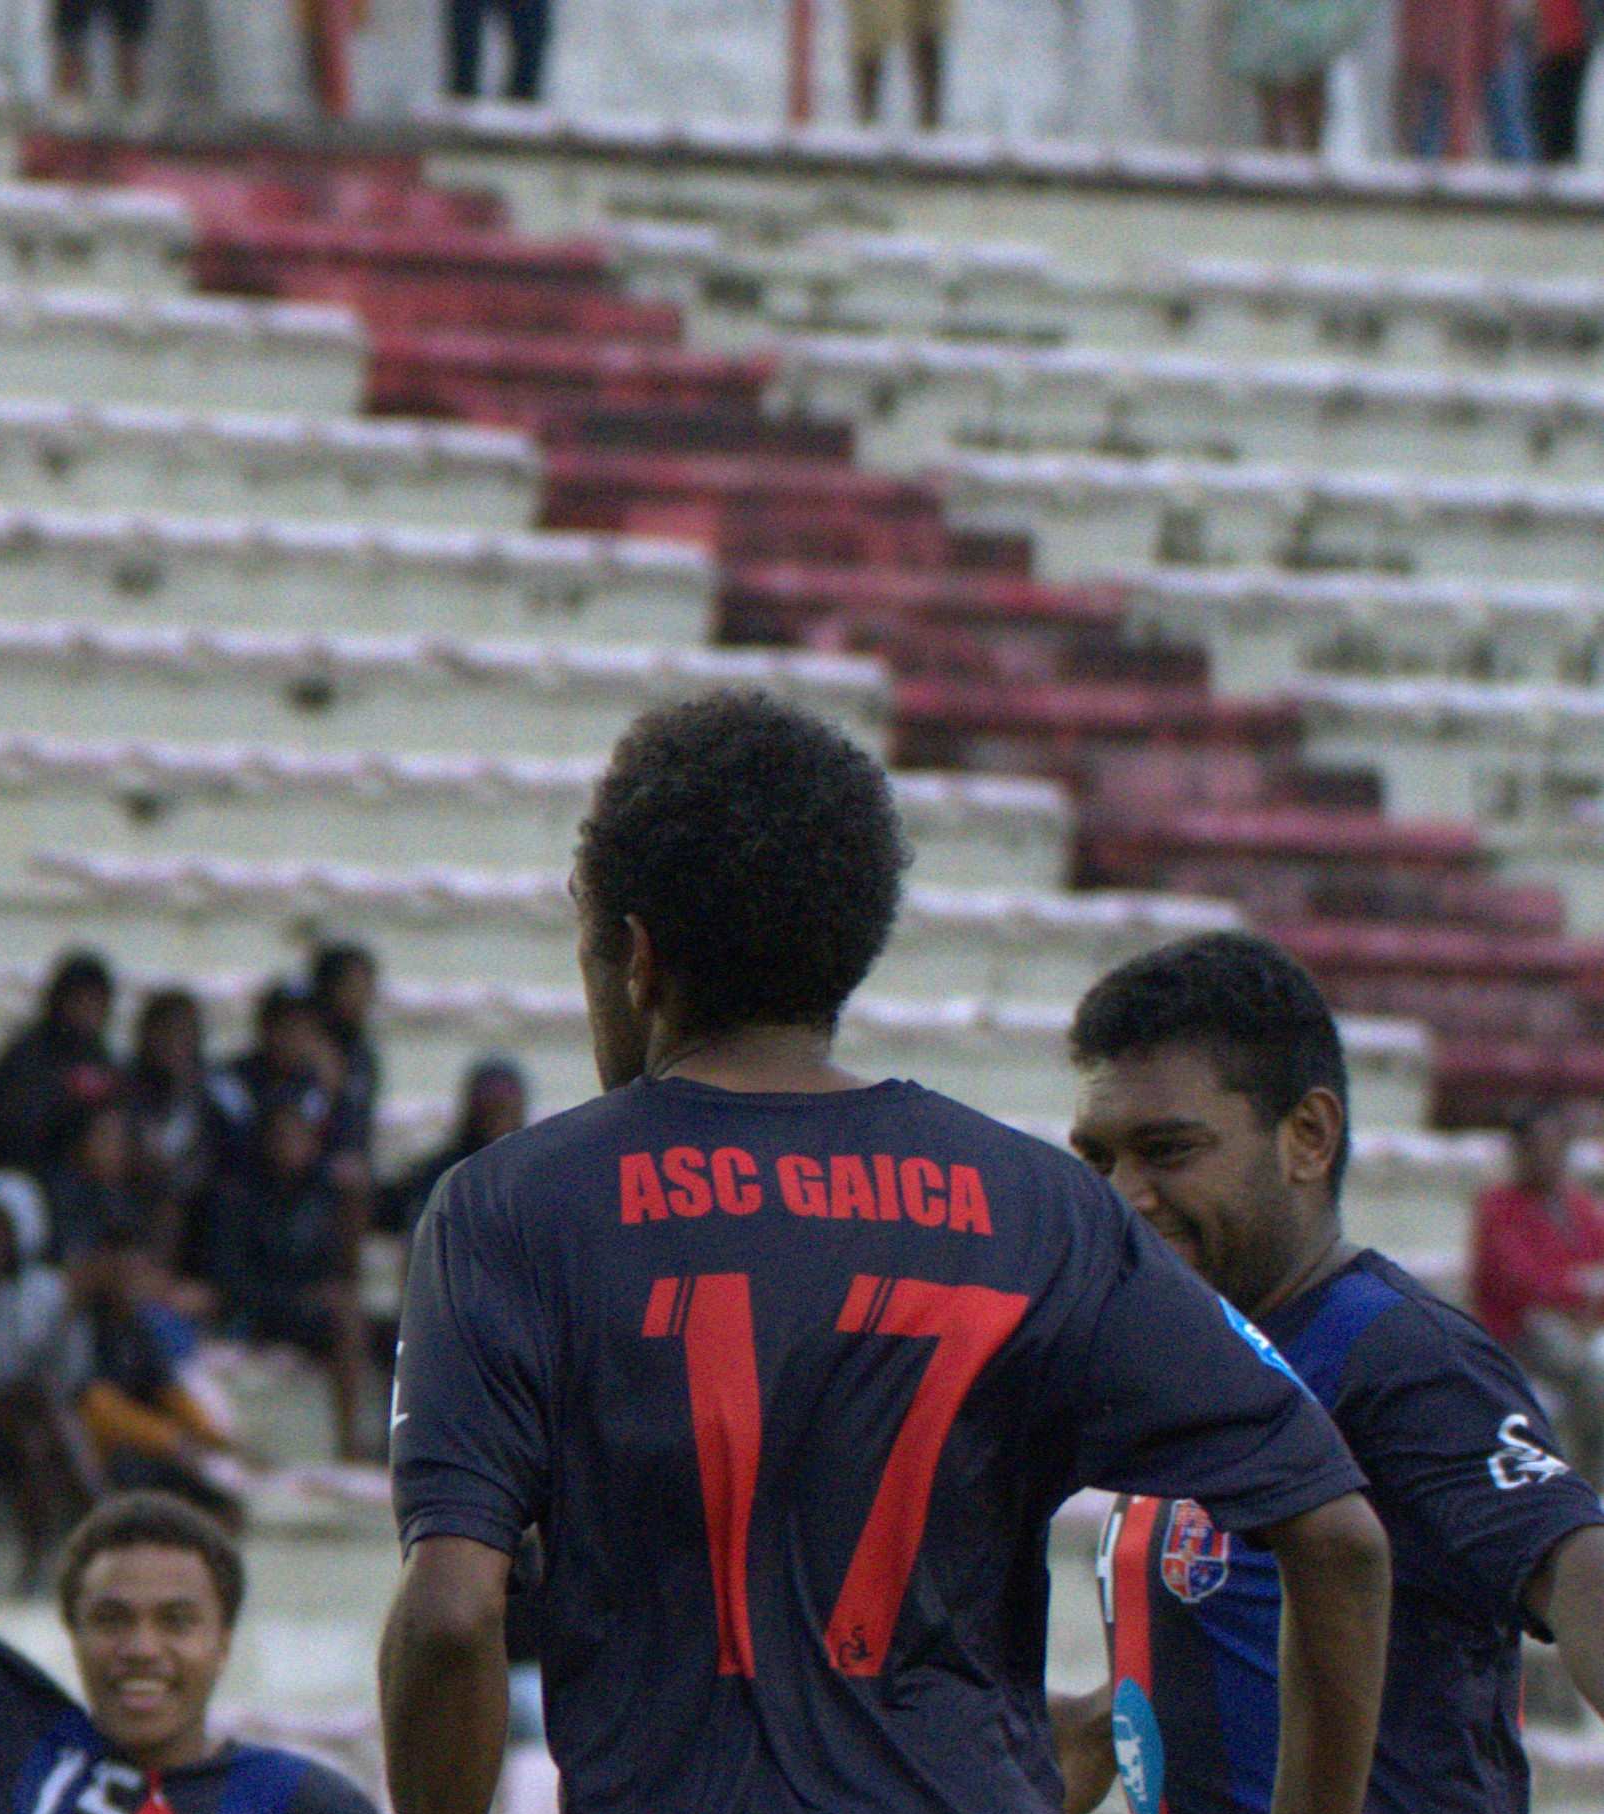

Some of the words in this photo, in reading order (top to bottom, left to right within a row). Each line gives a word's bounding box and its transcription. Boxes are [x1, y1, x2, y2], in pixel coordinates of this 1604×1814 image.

[618, 1146, 762, 1225] ASC
[775, 1153, 992, 1236] GAICA
[641, 1272, 1029, 1679] 17
